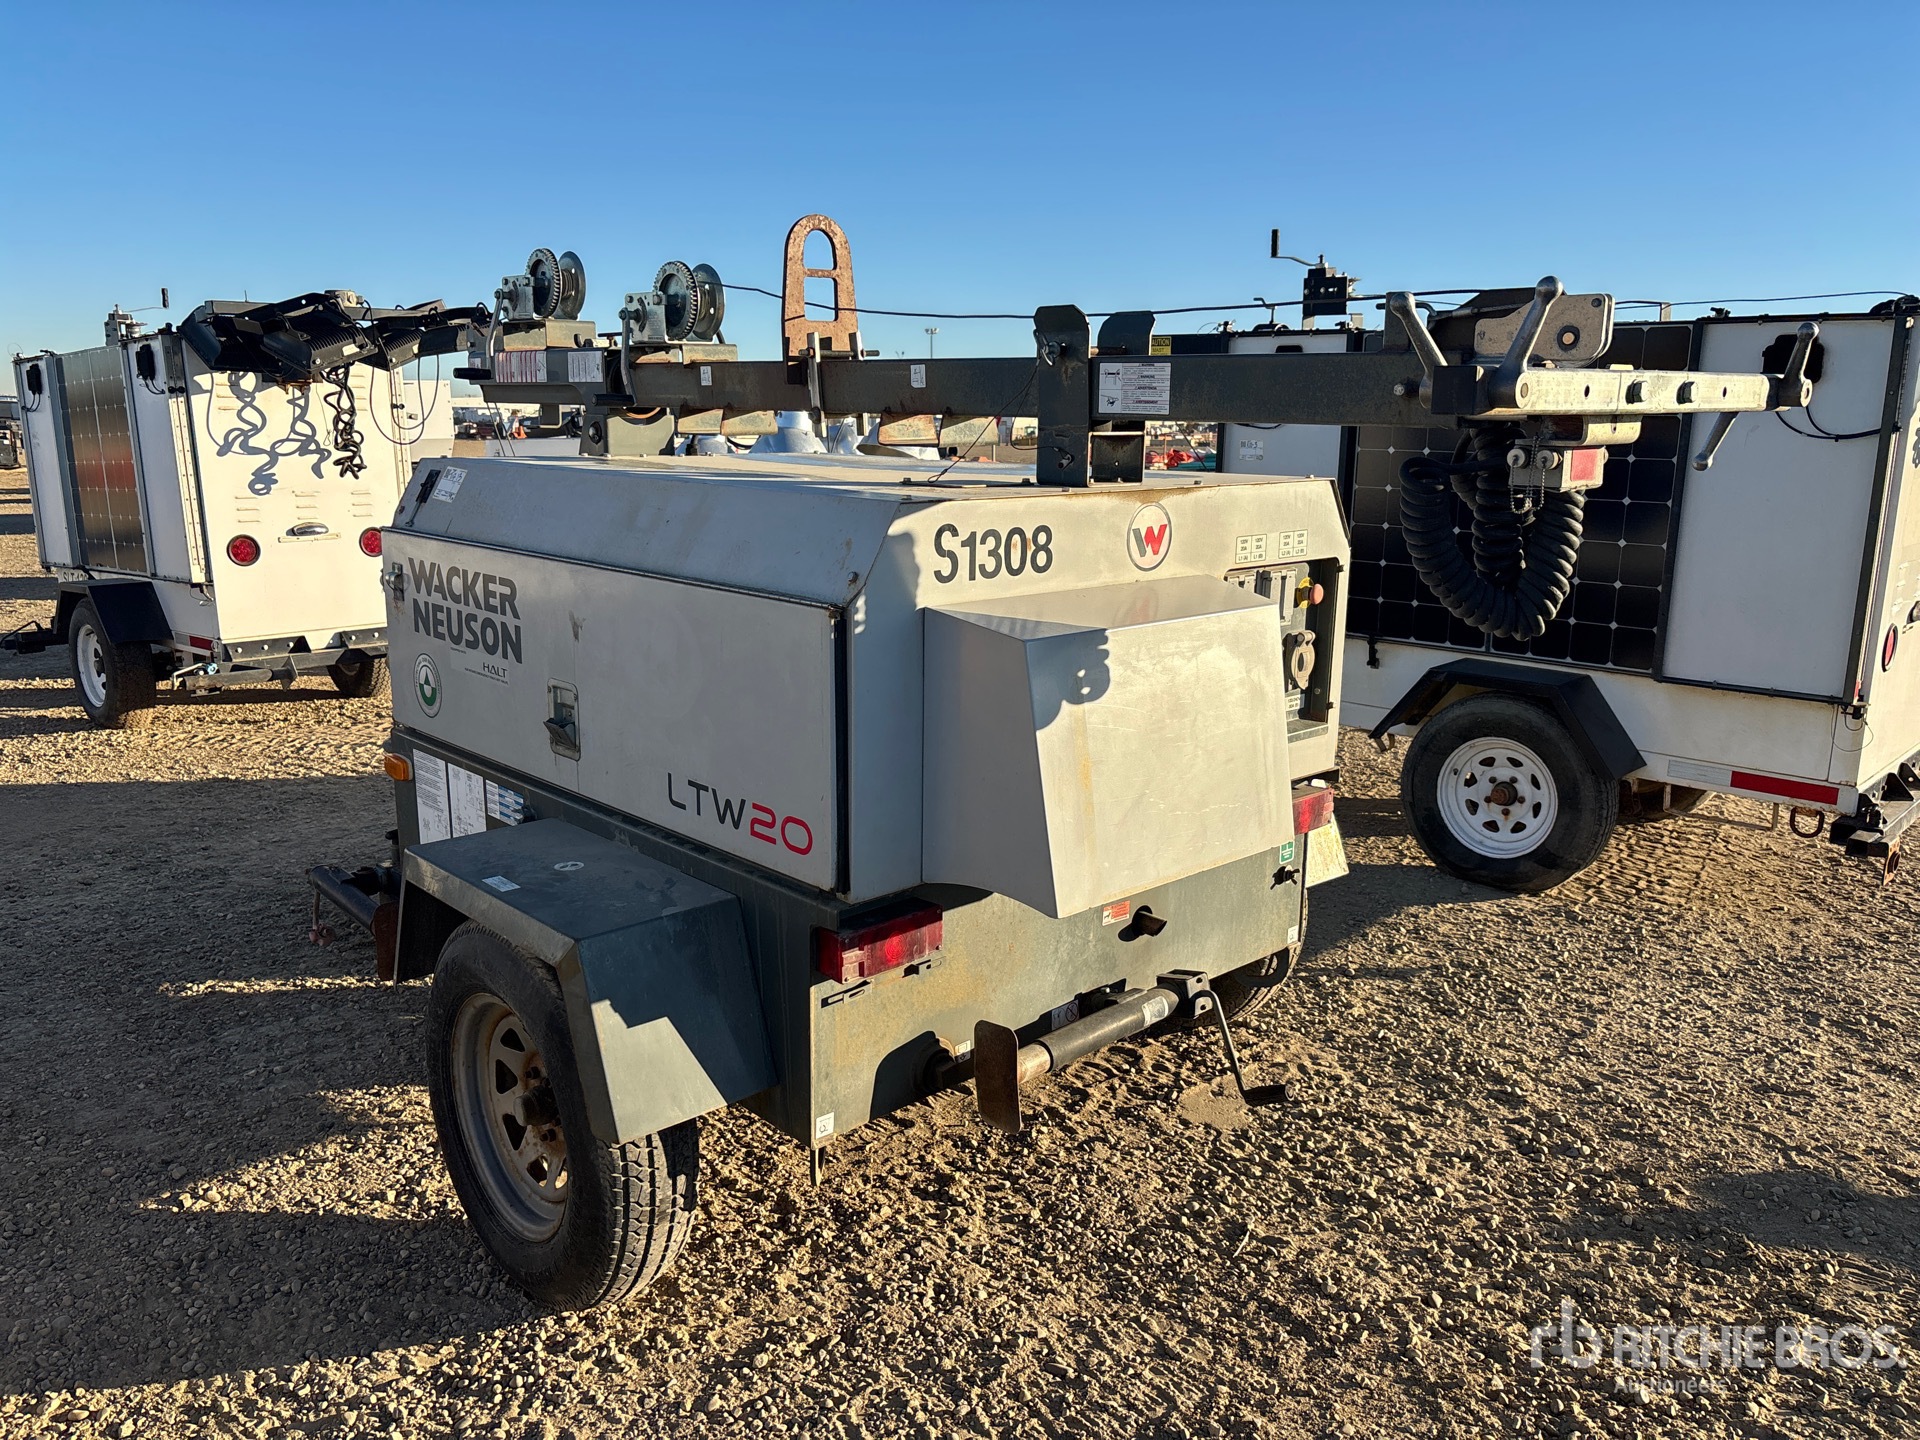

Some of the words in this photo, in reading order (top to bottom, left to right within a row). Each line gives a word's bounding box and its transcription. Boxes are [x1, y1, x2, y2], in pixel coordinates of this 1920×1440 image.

[1152, 338, 1170, 346] AUTION
[933, 523, 1053, 584] S1308
[408, 557, 521, 620] WACKER
[412, 598, 523, 664] NEUSON
[482, 661, 508, 679] HALT
[667, 772, 813, 856] LTW20
